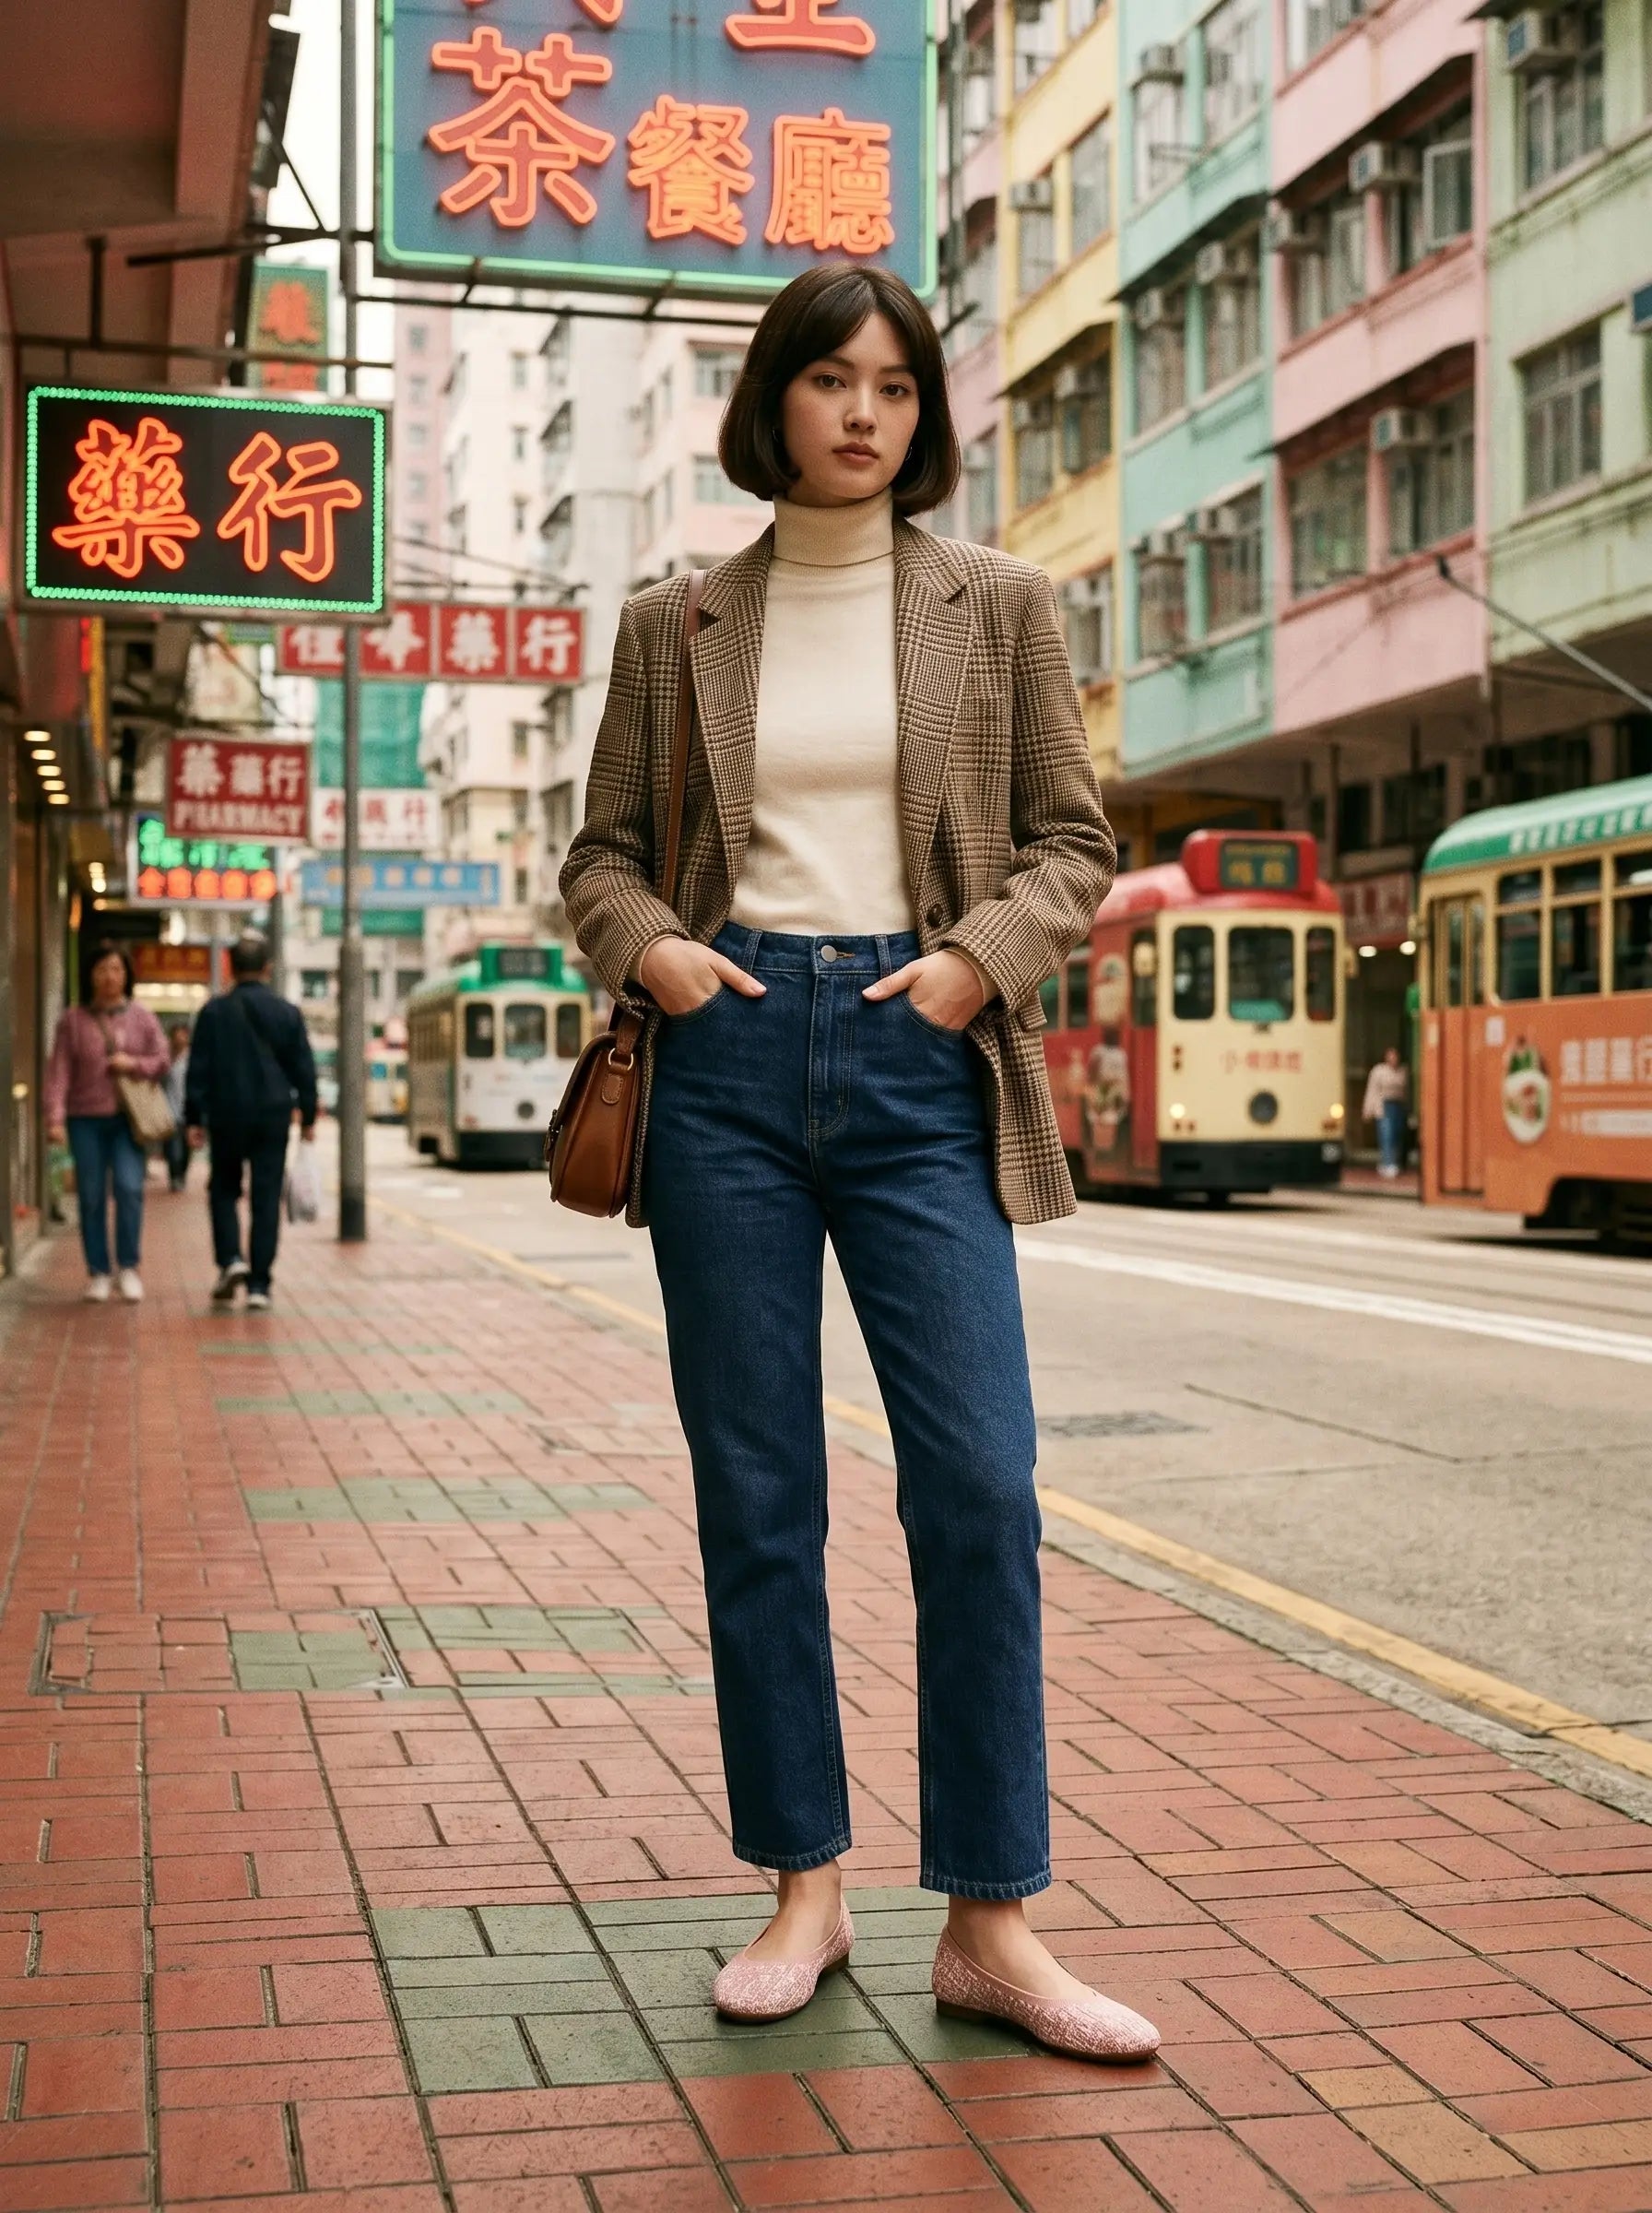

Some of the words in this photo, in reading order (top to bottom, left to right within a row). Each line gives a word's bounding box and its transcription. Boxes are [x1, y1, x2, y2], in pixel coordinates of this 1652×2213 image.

[429, 26, 894, 254] 茶餐廳
[53, 417, 362, 583] 藥行
